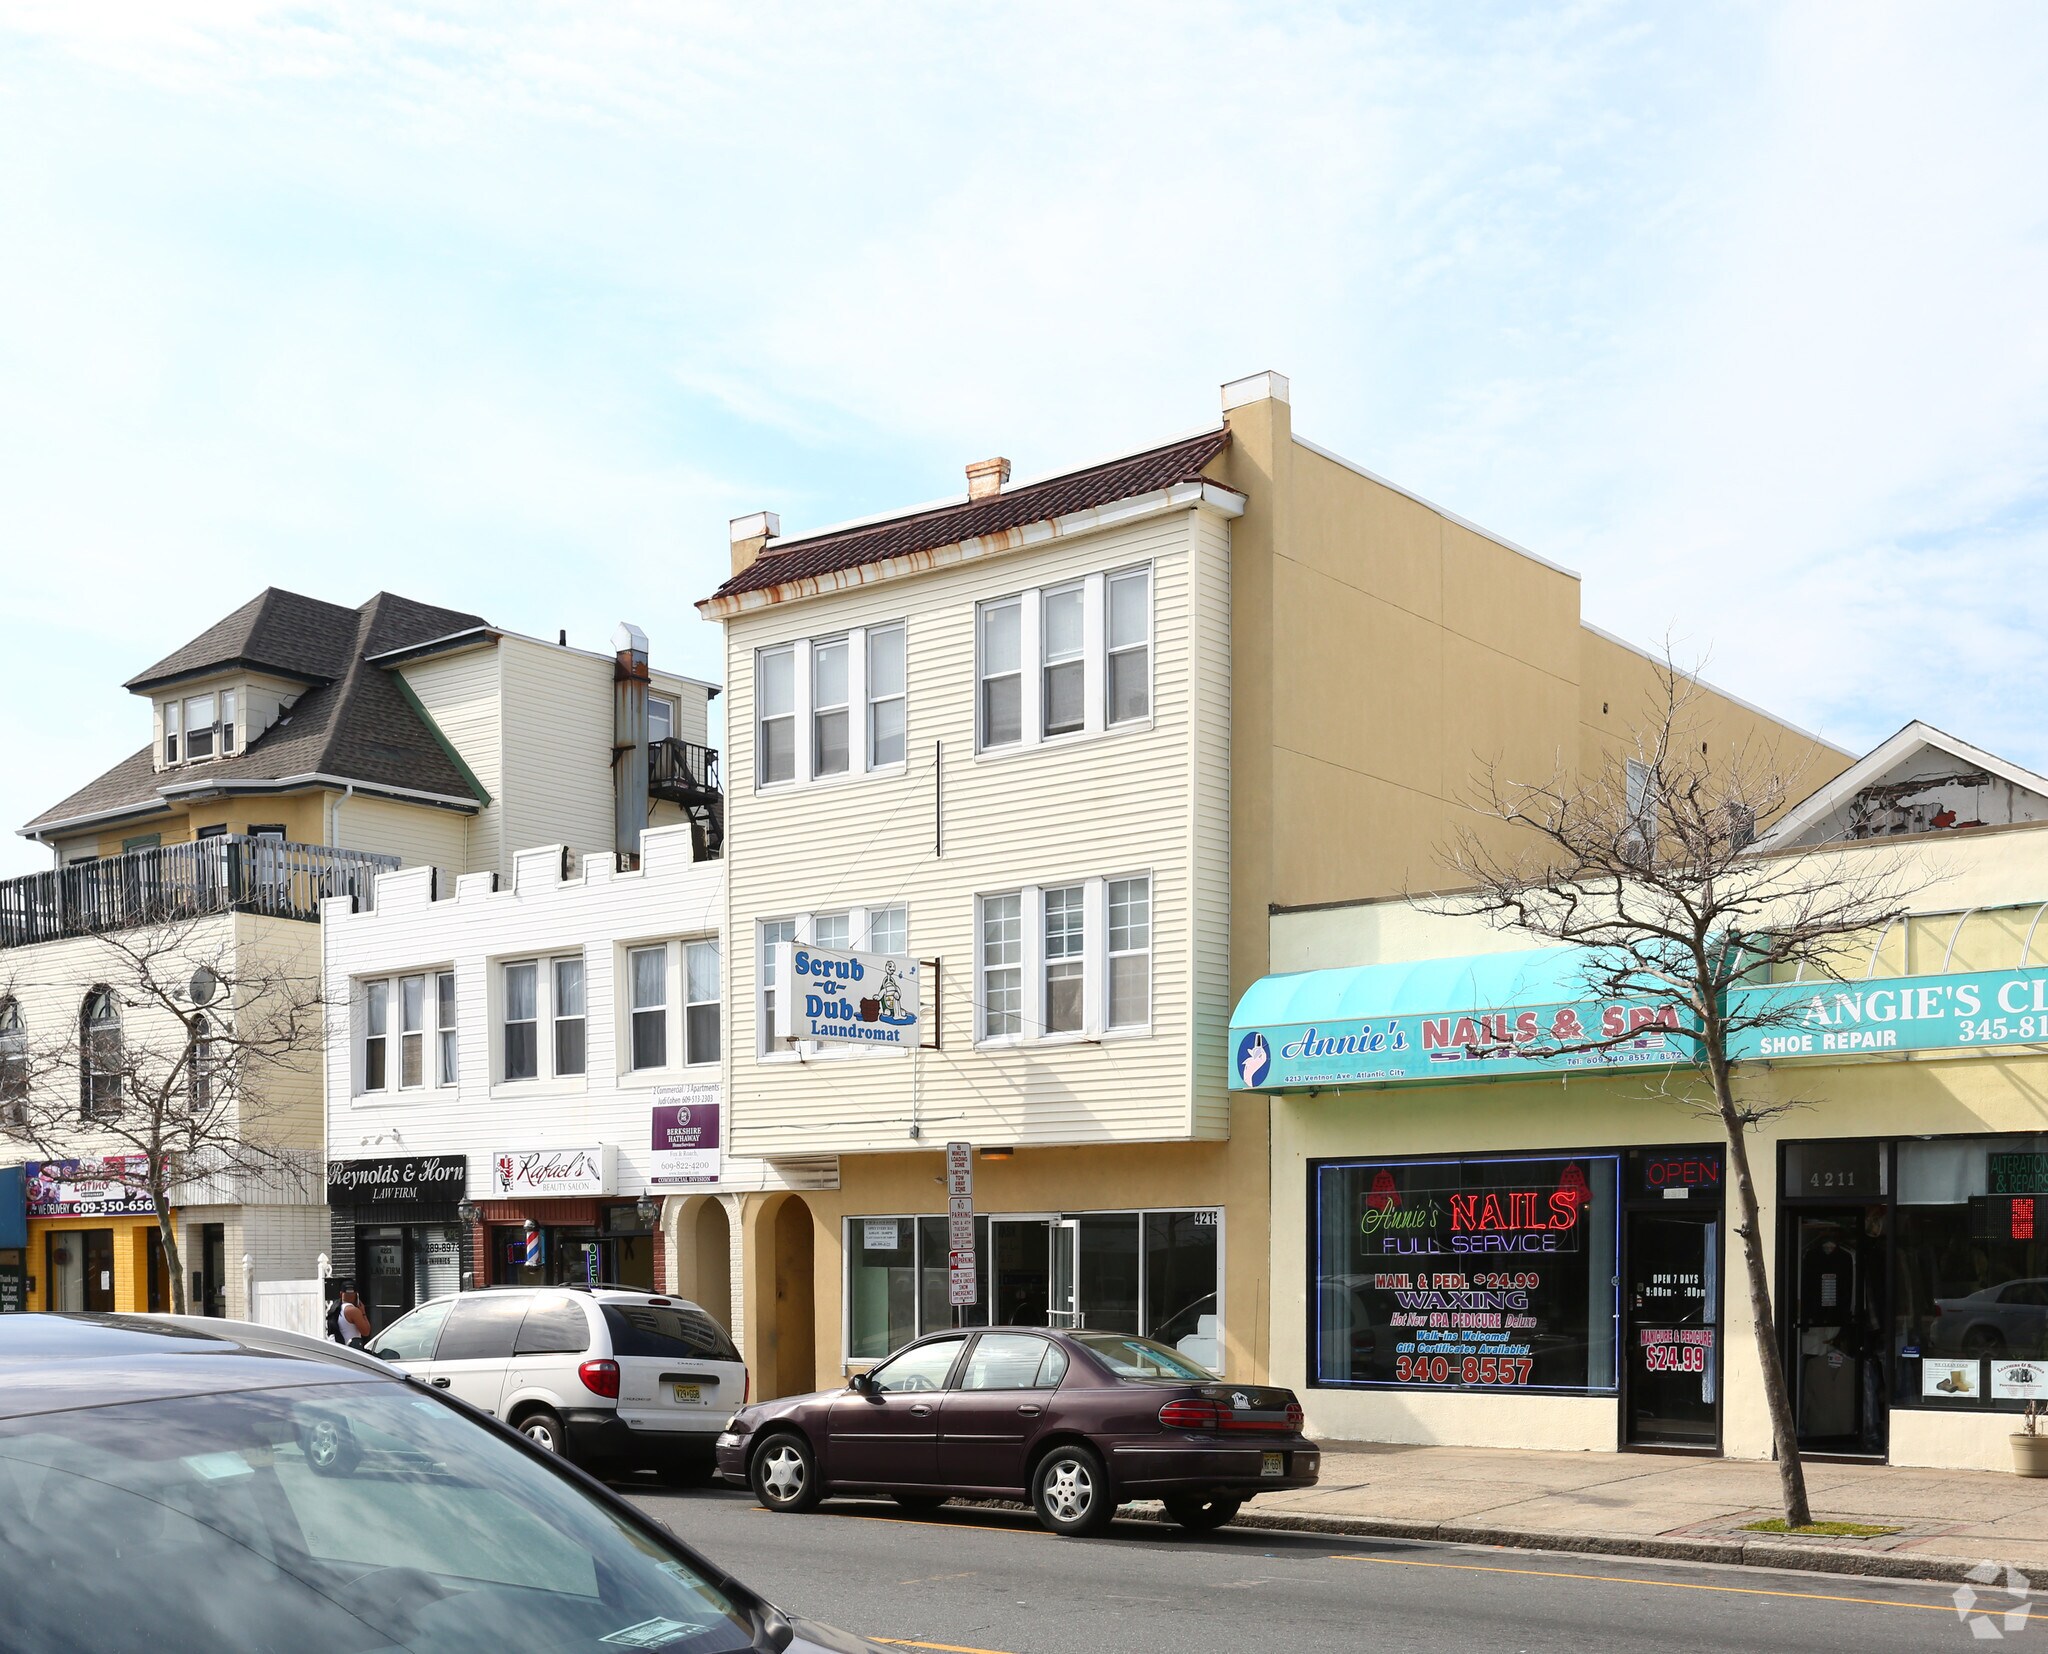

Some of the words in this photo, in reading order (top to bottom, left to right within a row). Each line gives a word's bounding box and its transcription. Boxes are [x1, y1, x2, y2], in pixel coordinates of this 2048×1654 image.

[795, 951, 864, 981] Scrub
[805, 994, 854, 1021] Dub
[1801, 985, 1981, 1026] ANGIE'S
[811, 1020, 900, 1042] Laundromat
[1281, 1020, 1409, 1060] Annie's
[1422, 1011, 1538, 1050] NAILS
[1550, 1008, 1584, 1040] &
[1600, 1004, 1681, 1037] SPA
[1760, 1034, 1813, 1054] SHOE
[1823, 1030, 1897, 1050] REPAIR
[1628, 1053, 1651, 1061] 8557
[1356, 1071, 1385, 1079] Atlantic
[1389, 1069, 1405, 1077] City
[656, 1086, 684, 1095] Commercial
[690, 1084, 720, 1094] Apartments
[667, 1127, 701, 1136] BERKSHIRE
[668, 1135, 700, 1143] HATHAWAY
[327, 1162, 400, 1190] Reynolds
[402, 1163, 416, 1182] &
[418, 1157, 464, 1182] Horn
[517, 1152, 586, 1187] Rafael's
[661, 1161, 710, 1170] 609-822-4200
[1649, 1161, 1718, 1185] OPEN
[568, 1182, 590, 1191] SALON
[1810, 1172, 1855, 1187] 4211
[1996, 1175, 2007, 1192] &
[373, 1188, 394, 1199] LAW
[395, 1187, 418, 1198] FIRM
[46, 1203, 70, 1214] DELIVERY
[1361, 1197, 1438, 1234] Annie's
[1450, 1191, 1577, 1231] NAILS
[1383, 1236, 1440, 1255] FULL
[1451, 1234, 1557, 1254] SERVICE
[951, 1256, 958, 1266] NO
[1375, 1273, 1413, 1289] MANI.
[1417, 1273, 1429, 1289] &
[1433, 1273, 1469, 1289] PEDI.
[1474, 1272, 1539, 1289] $24.99
[1653, 1274, 1671, 1284] OPEN
[1673, 1274, 1677, 1284] 7
[1680, 1274, 1699, 1284] DAYS
[1395, 1291, 1528, 1310] WAXING
[1390, 1312, 1406, 1327] Hot
[1406, 1312, 1428, 1327] New
[1430, 1312, 1448, 1328] SPA
[1452, 1312, 1501, 1328] PEDICURE
[1504, 1313, 1537, 1328] Deluxe
[1416, 1330, 1458, 1341] Walk-ins
[1462, 1330, 1510, 1342] Welcome!
[1640, 1329, 1673, 1346] MANICURE
[1674, 1330, 1680, 1343] &
[1680, 1330, 1713, 1347] PEDICURE
[1396, 1343, 1415, 1353] Gift
[1418, 1343, 1475, 1354] Certificates
[1478, 1344, 1530, 1356] Available!
[1646, 1345, 1704, 1372] $24.99
[1396, 1355, 1533, 1384] 340-8557
